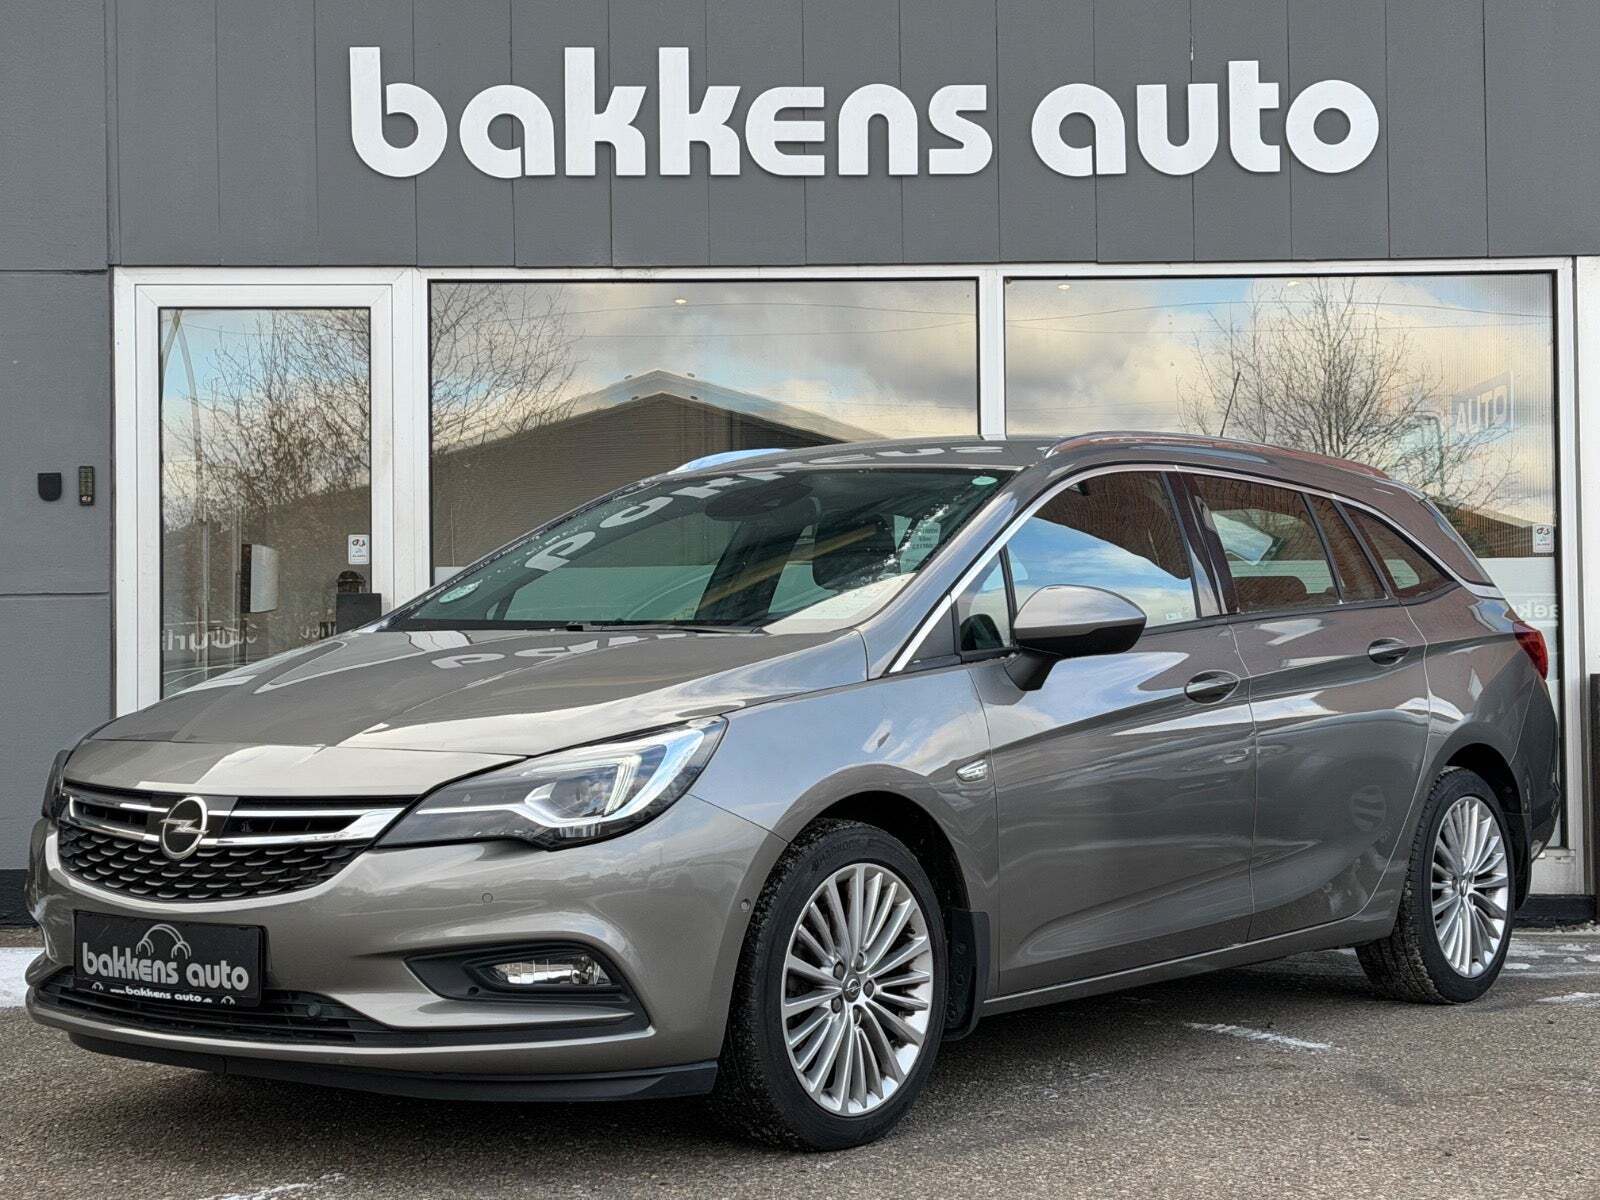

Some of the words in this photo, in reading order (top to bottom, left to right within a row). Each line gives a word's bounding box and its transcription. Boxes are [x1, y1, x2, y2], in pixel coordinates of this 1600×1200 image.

[349, 46, 993, 179] bakkens
[1031, 60, 1380, 178] auto
[82, 942, 179, 985] bakkens
[185, 959, 249, 991] auto
